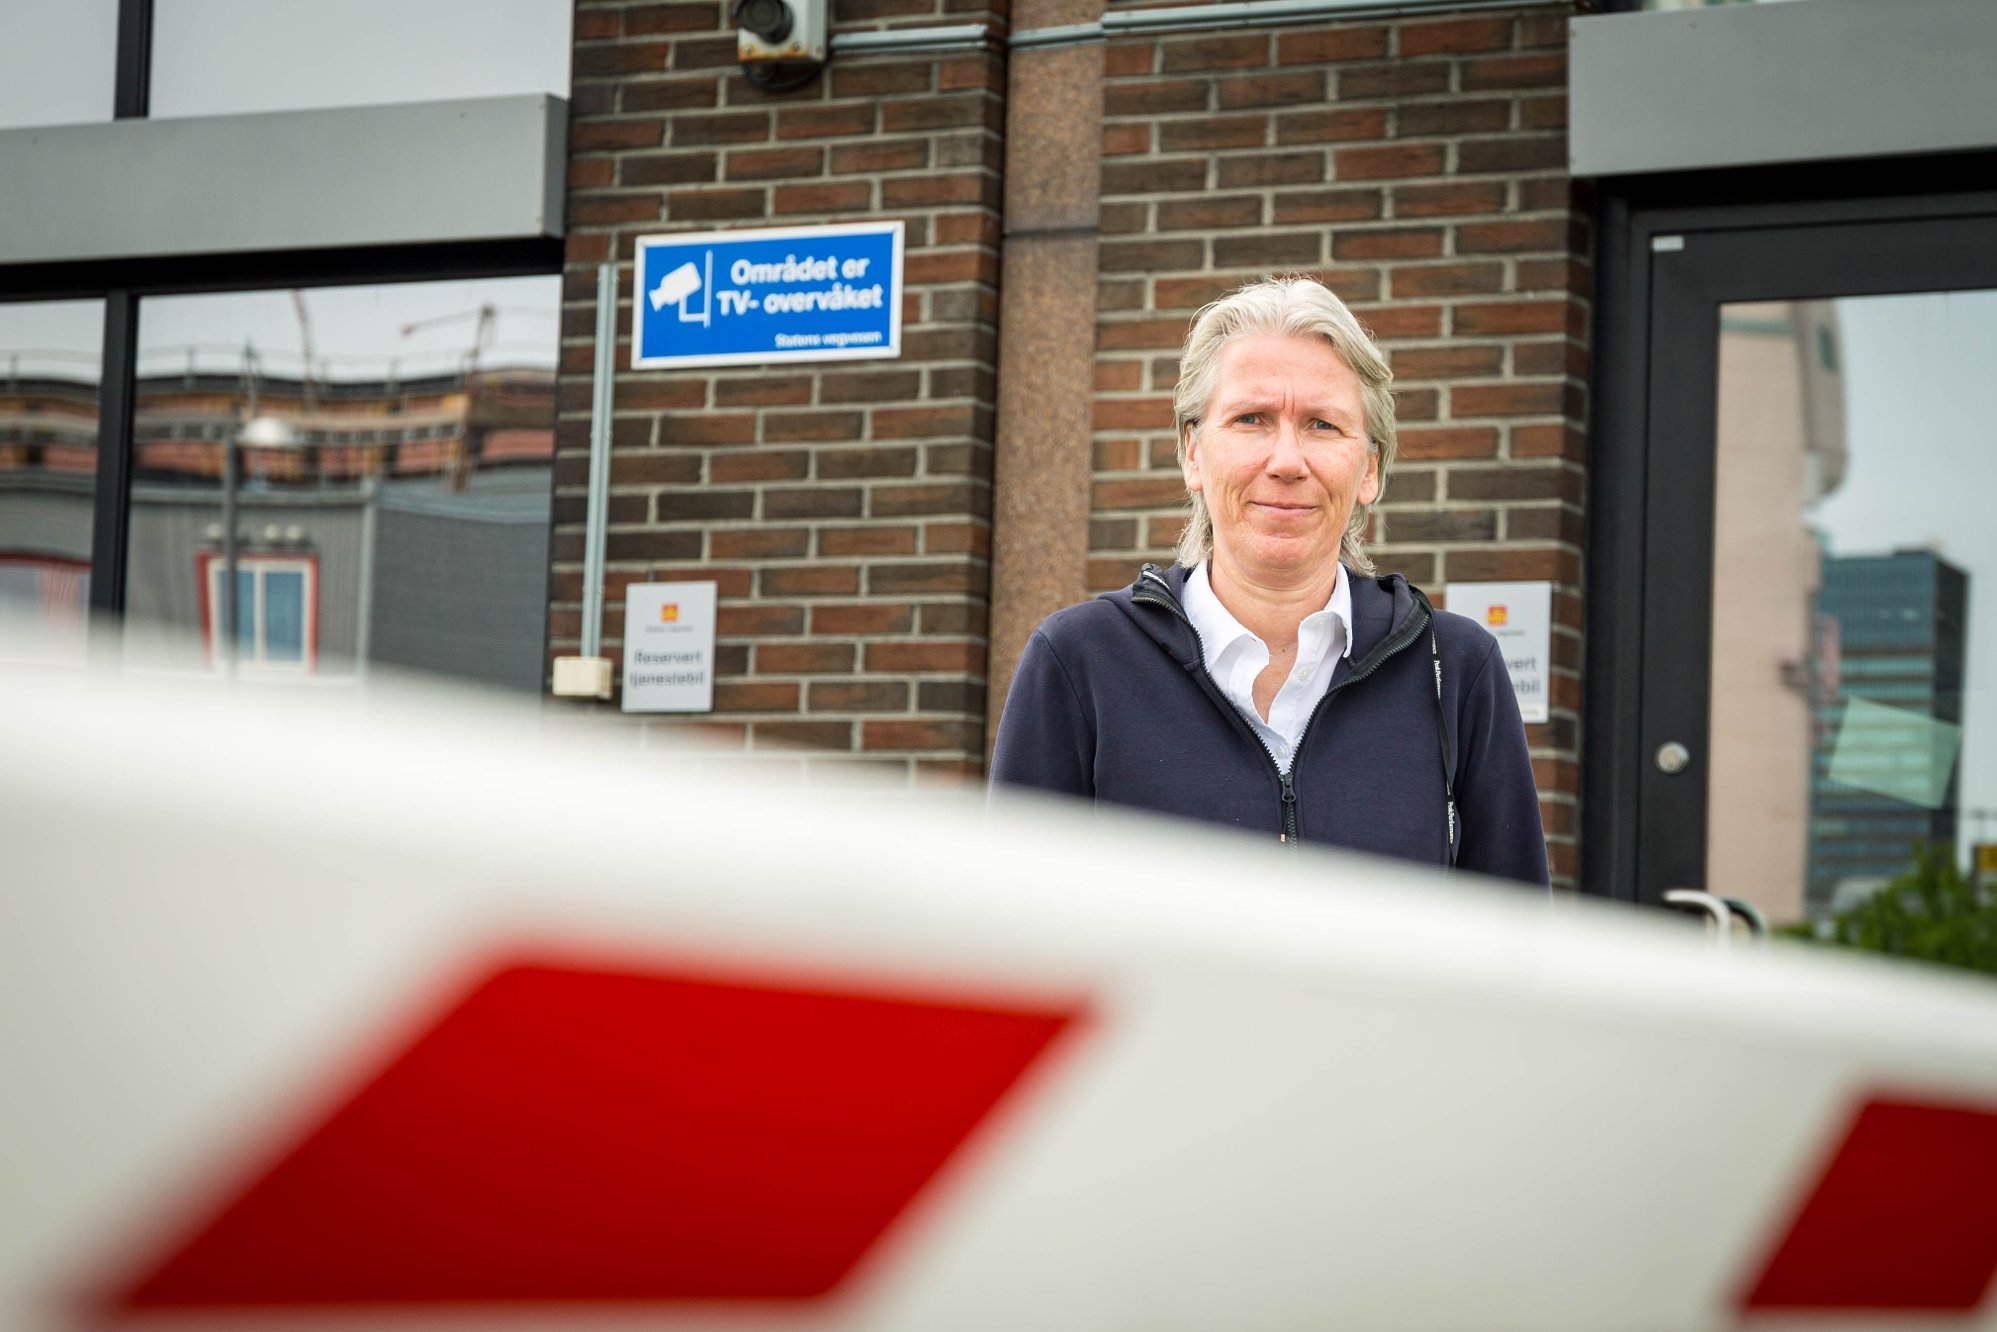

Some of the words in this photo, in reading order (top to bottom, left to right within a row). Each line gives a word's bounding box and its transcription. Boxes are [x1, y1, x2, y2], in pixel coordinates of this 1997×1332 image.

[731, 253, 838, 285] Området
[841, 257, 871, 280] er
[716, 289, 760, 316] TV-
[763, 282, 884, 315] overvåket
[634, 649, 703, 664] Reservert
